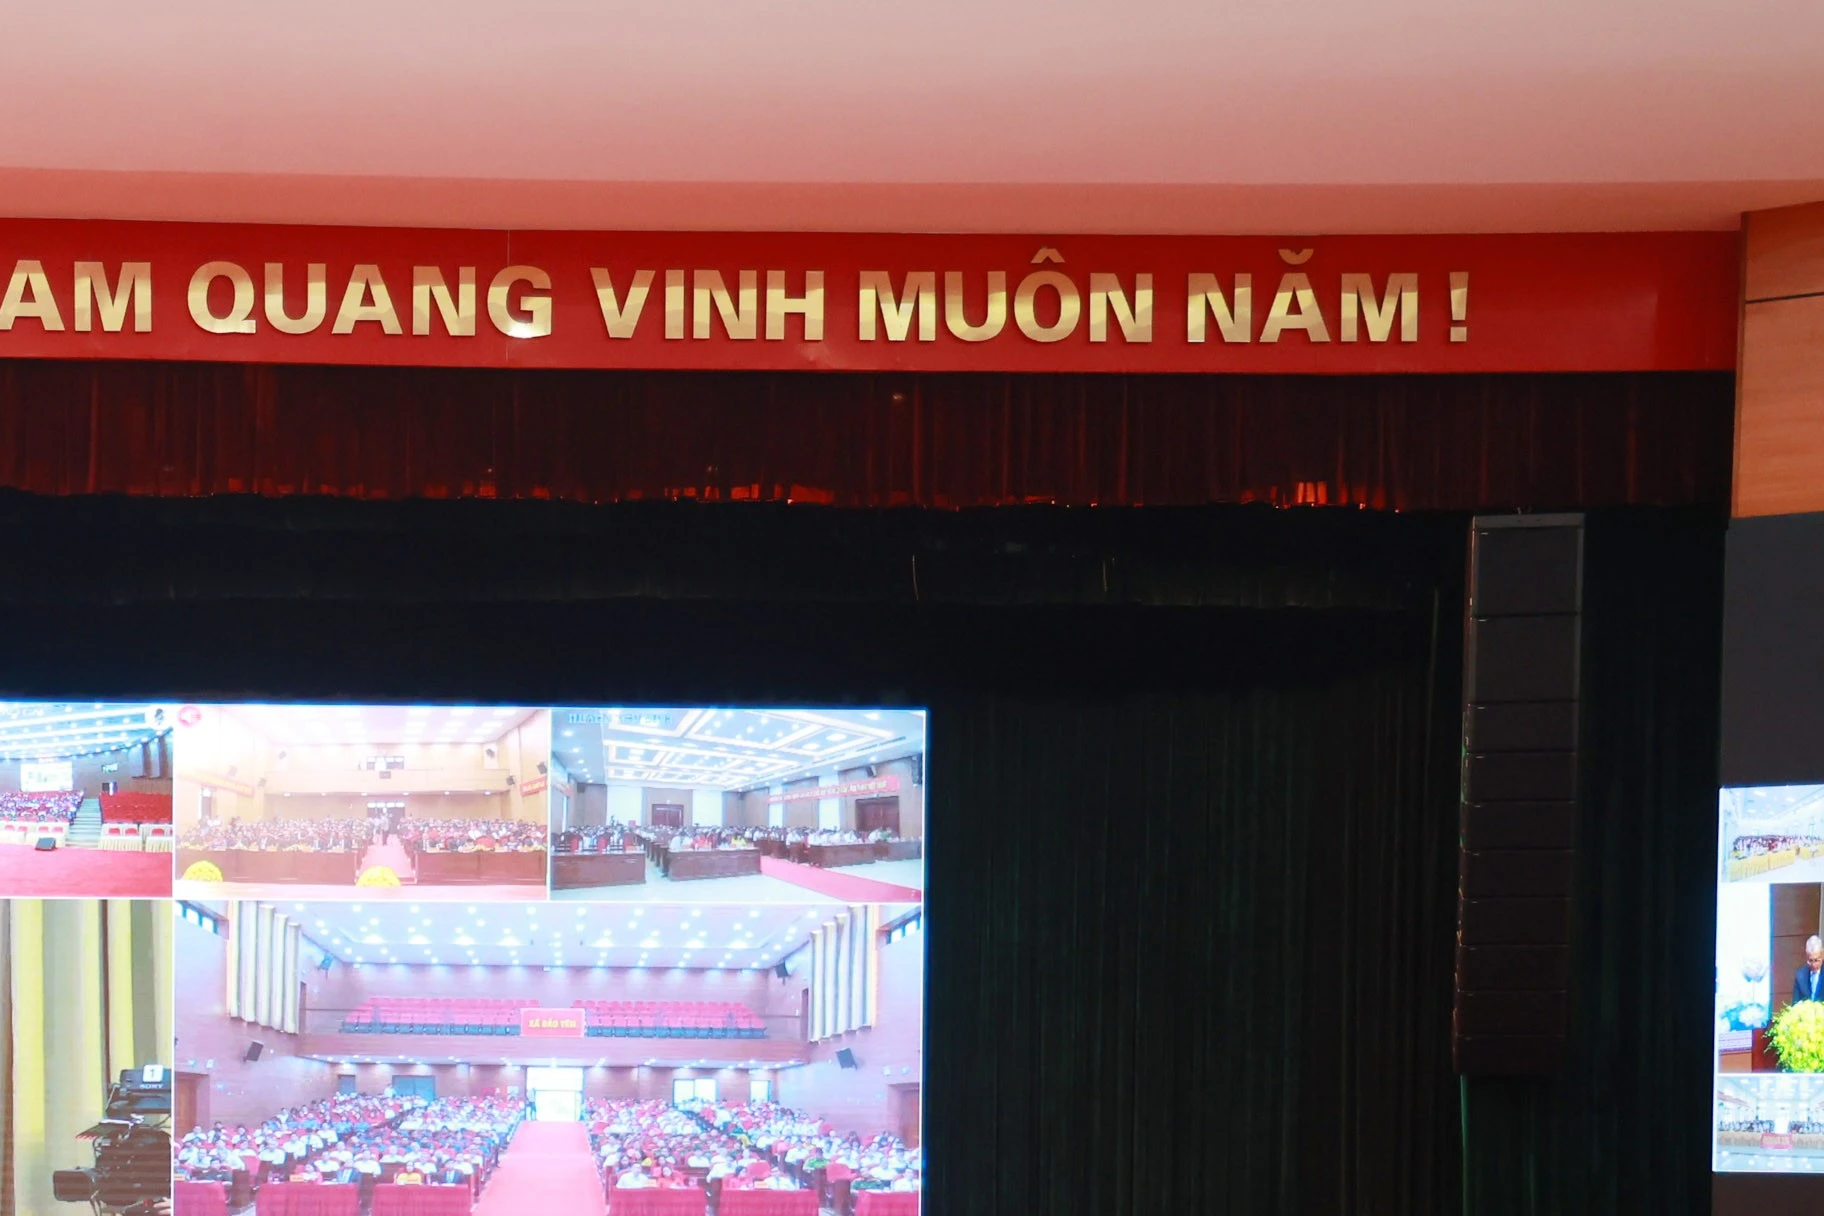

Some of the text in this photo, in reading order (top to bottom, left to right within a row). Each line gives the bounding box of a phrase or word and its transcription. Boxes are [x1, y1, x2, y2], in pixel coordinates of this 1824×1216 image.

[187, 261, 553, 339] QUANG
[590, 267, 824, 341] VINH
[859, 247, 1154, 343] MUÔN
[1187, 248, 1419, 343] NĂM
